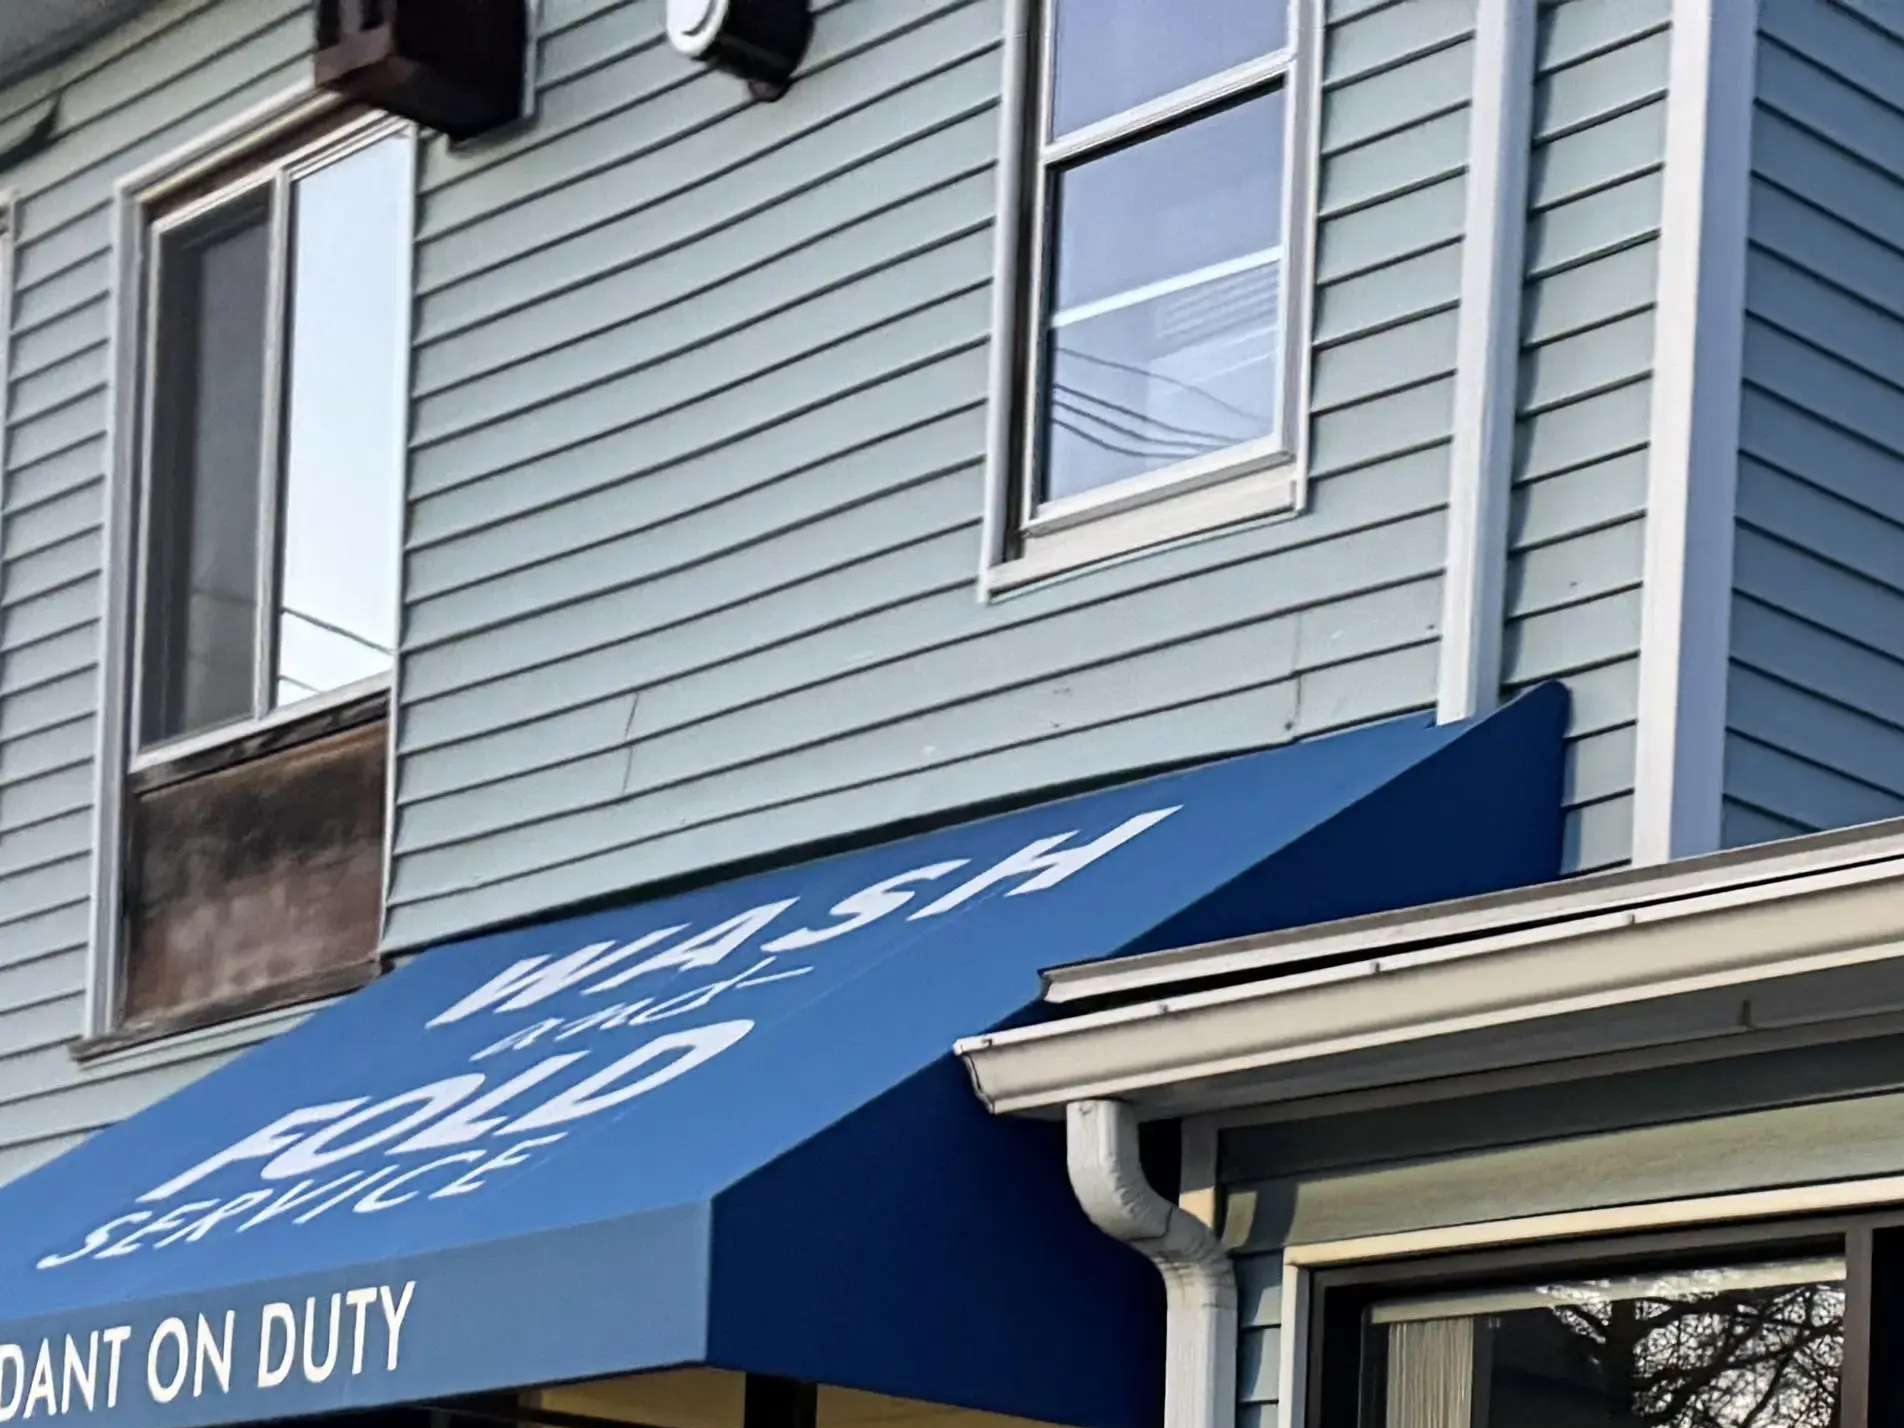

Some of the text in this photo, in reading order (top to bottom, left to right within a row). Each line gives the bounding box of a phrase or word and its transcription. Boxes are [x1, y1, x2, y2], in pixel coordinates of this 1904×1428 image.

[424, 803, 1184, 1029] WASH
[467, 955, 815, 1061] and
[133, 1018, 757, 1203] FOLD
[35, 1131, 569, 1270] SERVICE
[146, 1309, 236, 1404] ON
[256, 1280, 417, 1390] DUTY
